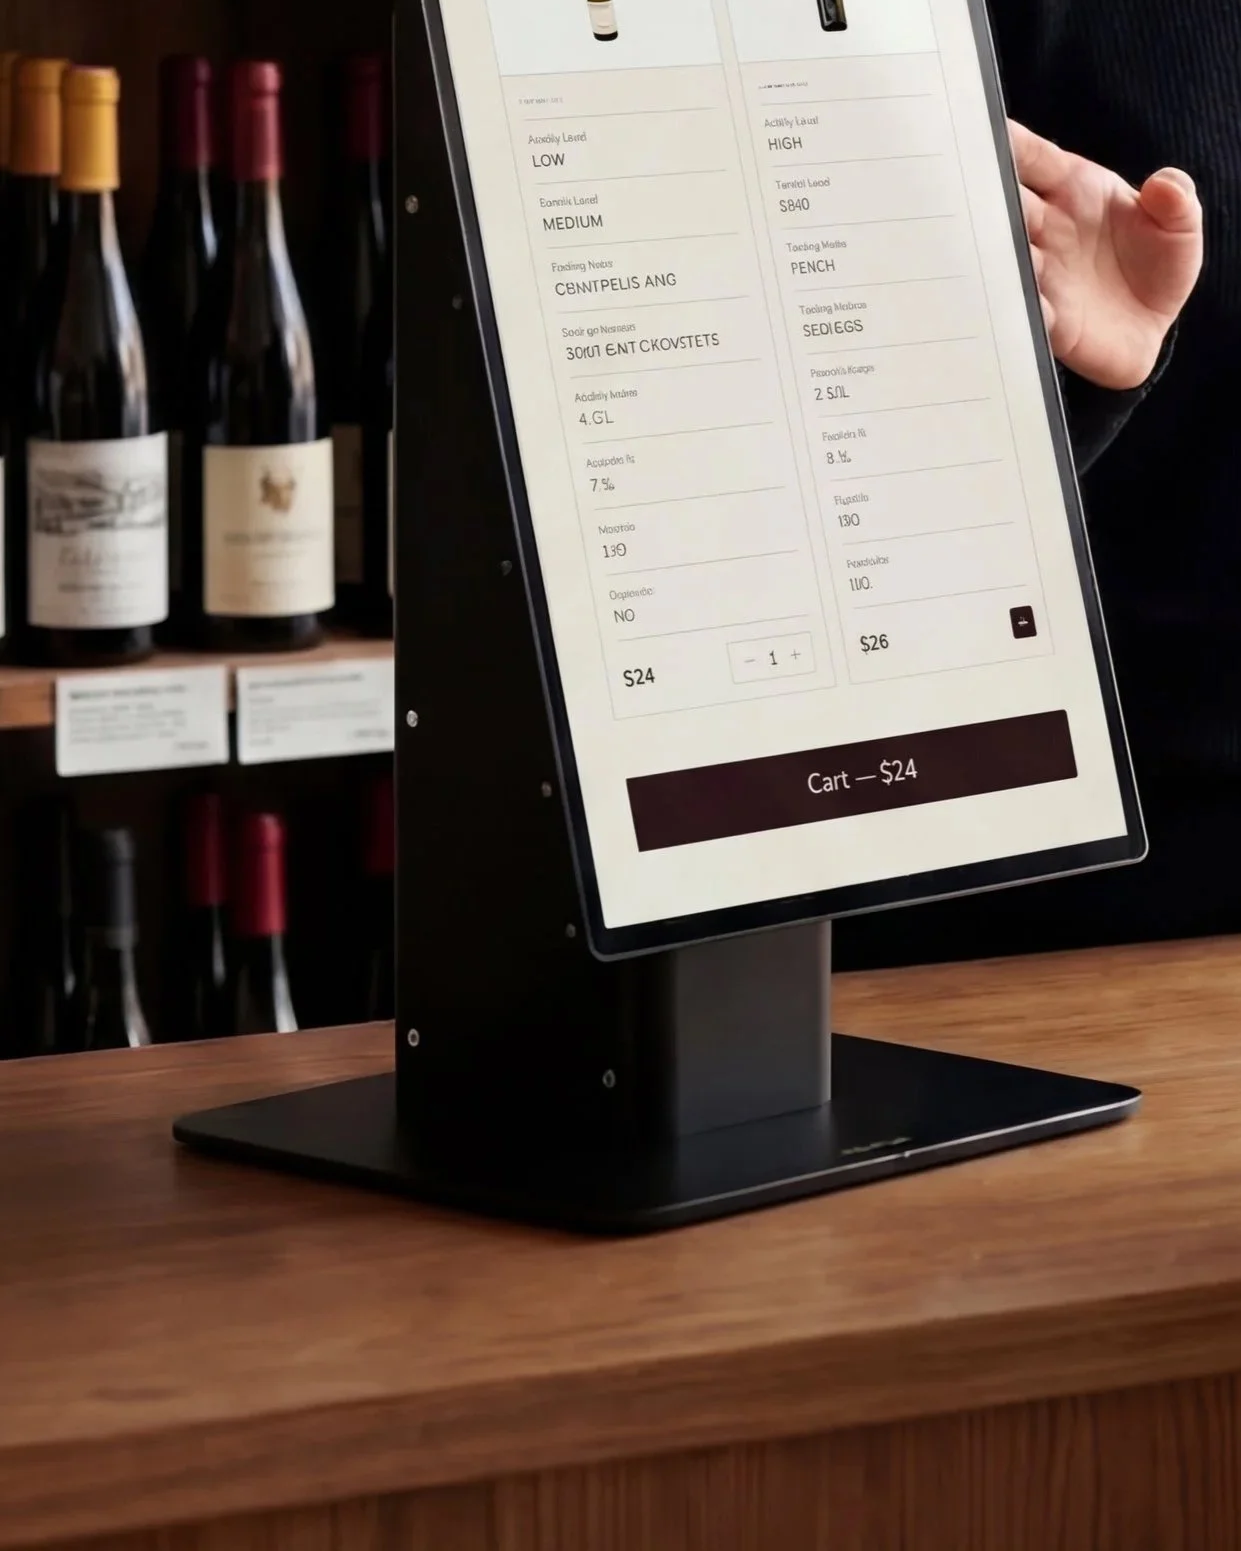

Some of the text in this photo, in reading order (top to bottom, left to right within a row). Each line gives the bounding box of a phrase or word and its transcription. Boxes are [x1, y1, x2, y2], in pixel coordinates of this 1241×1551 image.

[768, 137, 802, 150] HIGH
[532, 153, 564, 167] LOW
[543, 215, 602, 231] MEDIUM
[791, 260, 835, 274] PENCH
[645, 273, 676, 287] ANG
[614, 609, 635, 622] NO
[860, 634, 888, 654] $26
[770, 651, 777, 665] 1
[808, 771, 850, 793] Cart
